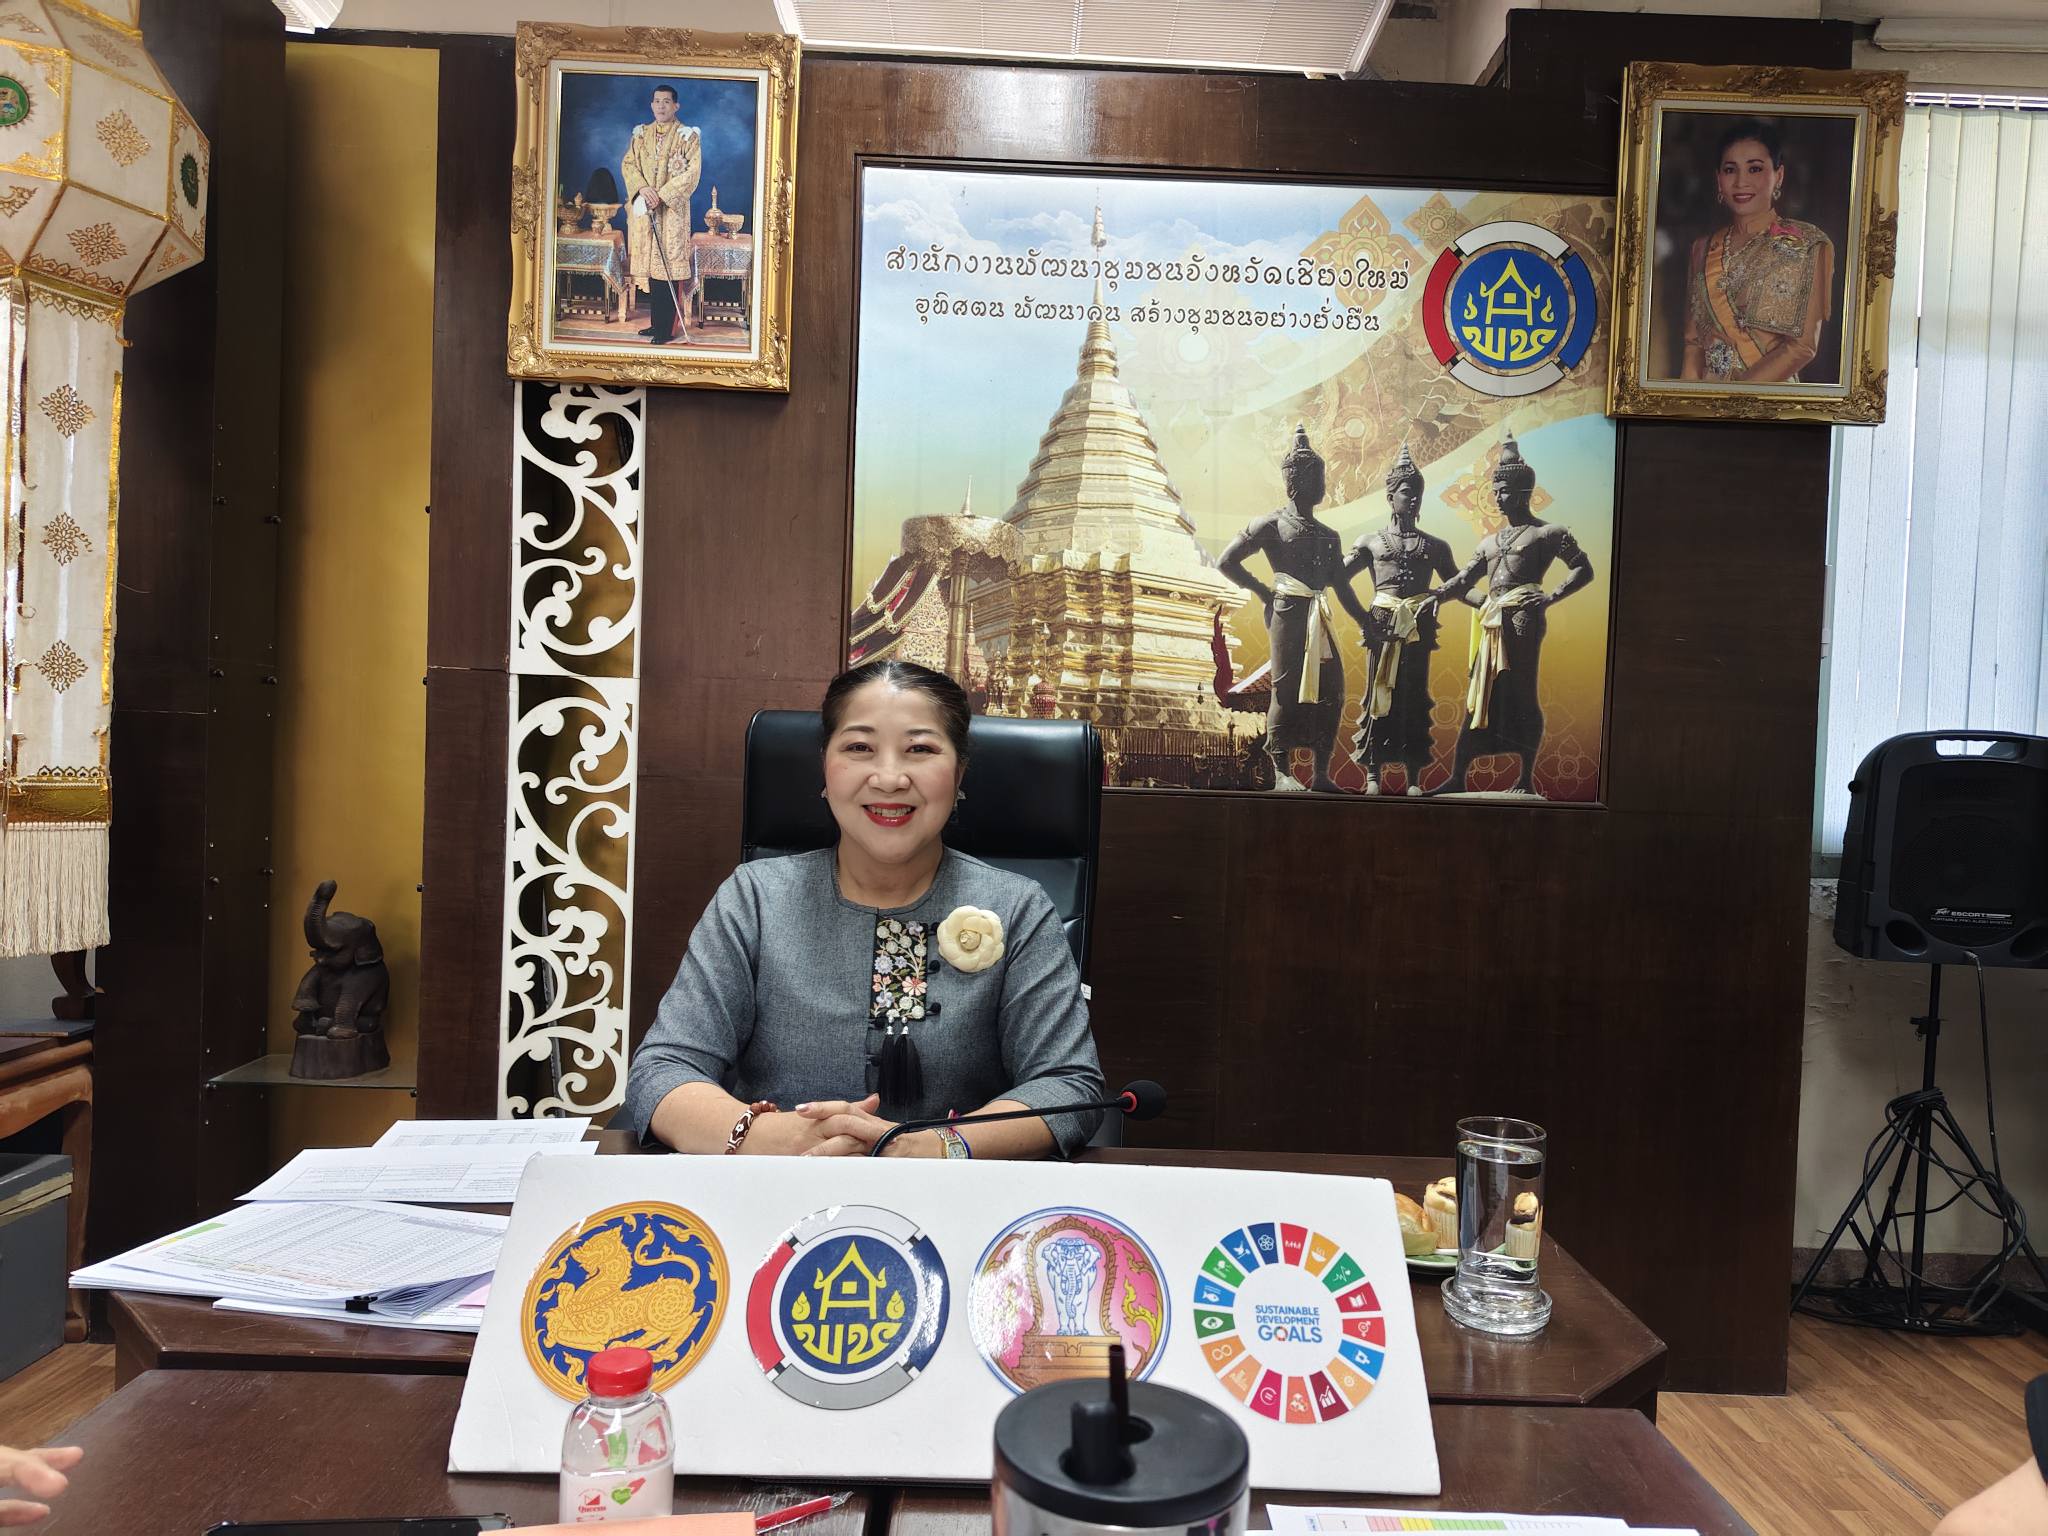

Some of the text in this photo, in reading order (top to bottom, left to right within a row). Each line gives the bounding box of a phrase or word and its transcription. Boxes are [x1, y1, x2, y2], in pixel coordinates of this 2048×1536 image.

[886, 243, 1410, 291] สำนักงานพัฒนาชุมชนจังหวัดเชียงใหม่
[915, 291, 1380, 336] อุทิศตน พัฒนาคน สร้างชุมชนอย่างยั่งยืน
[1255, 1304, 1320, 1316] SUSTAINABLE
[1256, 1315, 1320, 1326] DEVELOPMENT
[1258, 1324, 1323, 1343] GOALS
